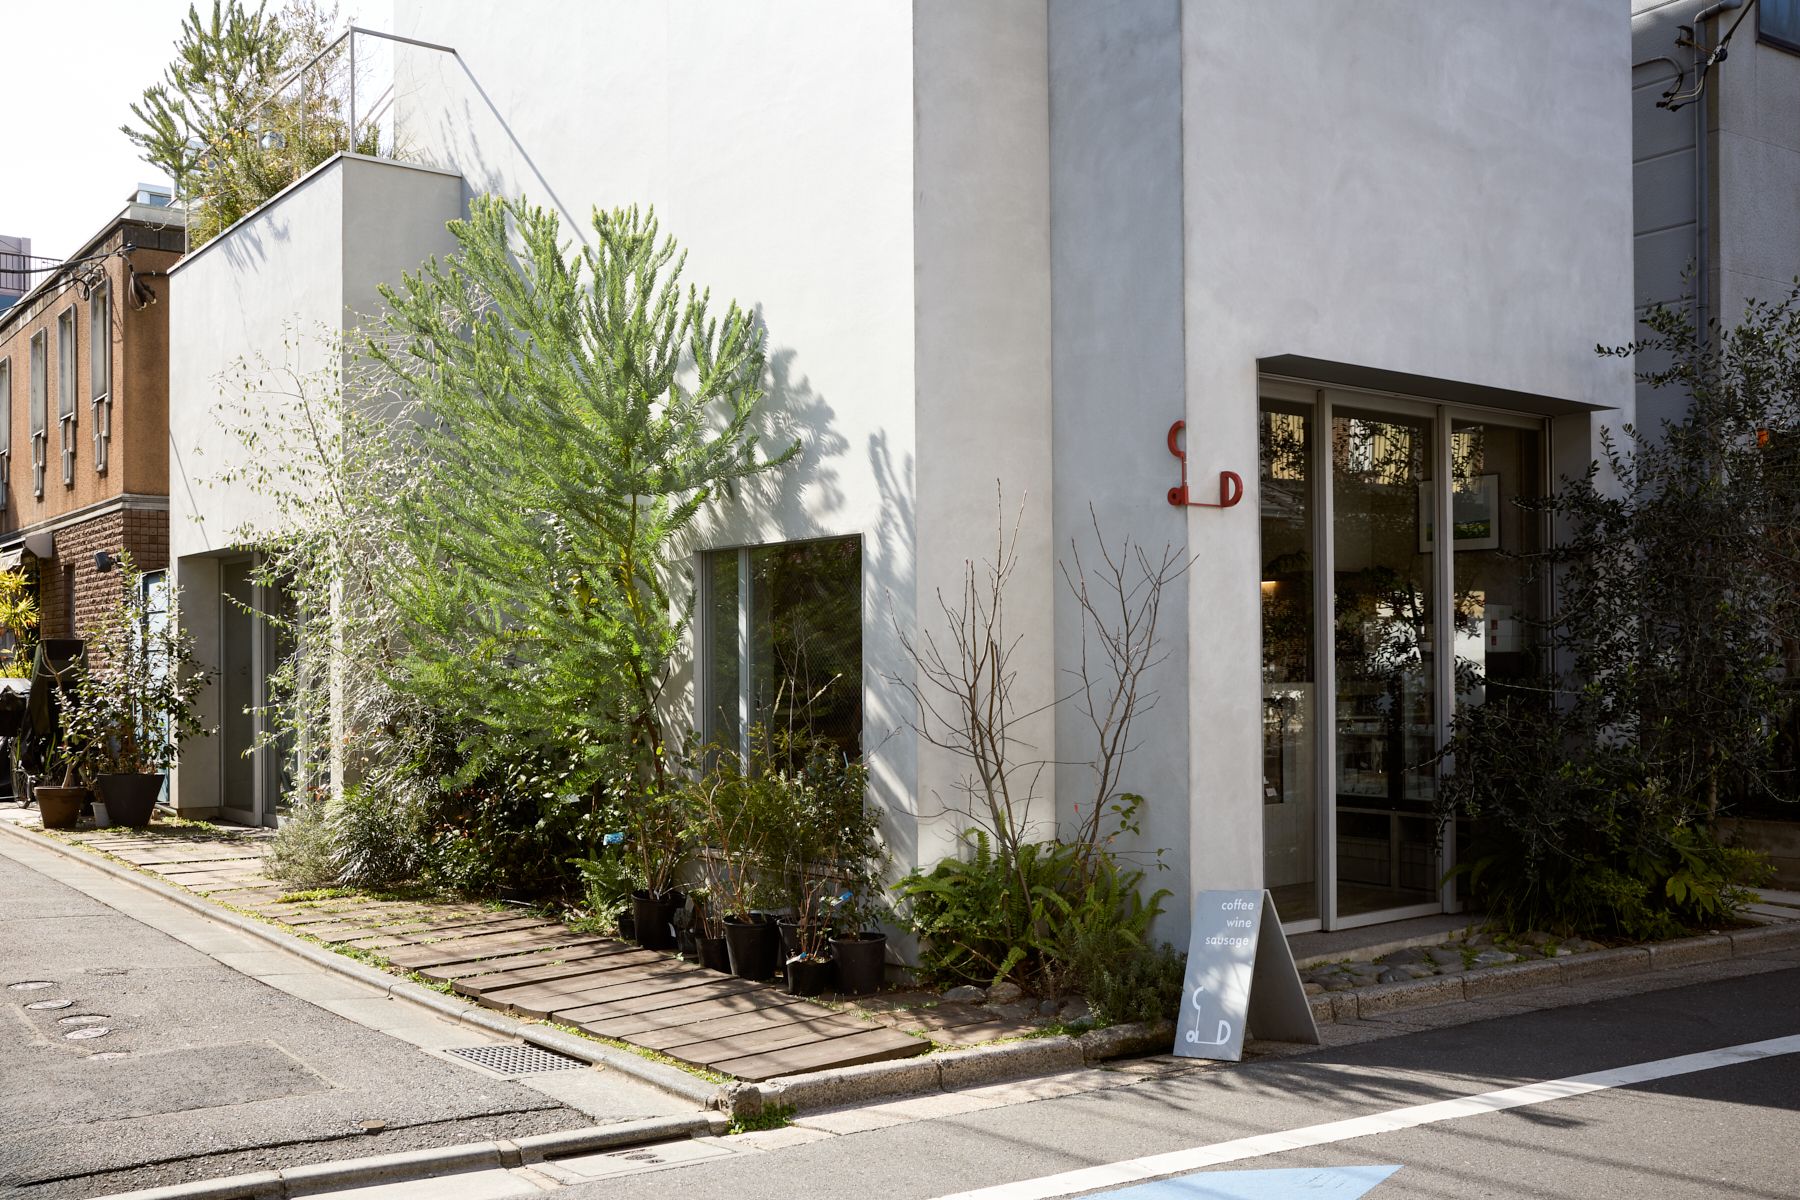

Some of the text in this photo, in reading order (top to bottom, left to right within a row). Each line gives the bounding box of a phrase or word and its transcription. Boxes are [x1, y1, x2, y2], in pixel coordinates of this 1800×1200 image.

[1221, 898, 1254, 911] coffee
[1226, 916, 1252, 928] wine
[1205, 936, 1249, 948] sausage
